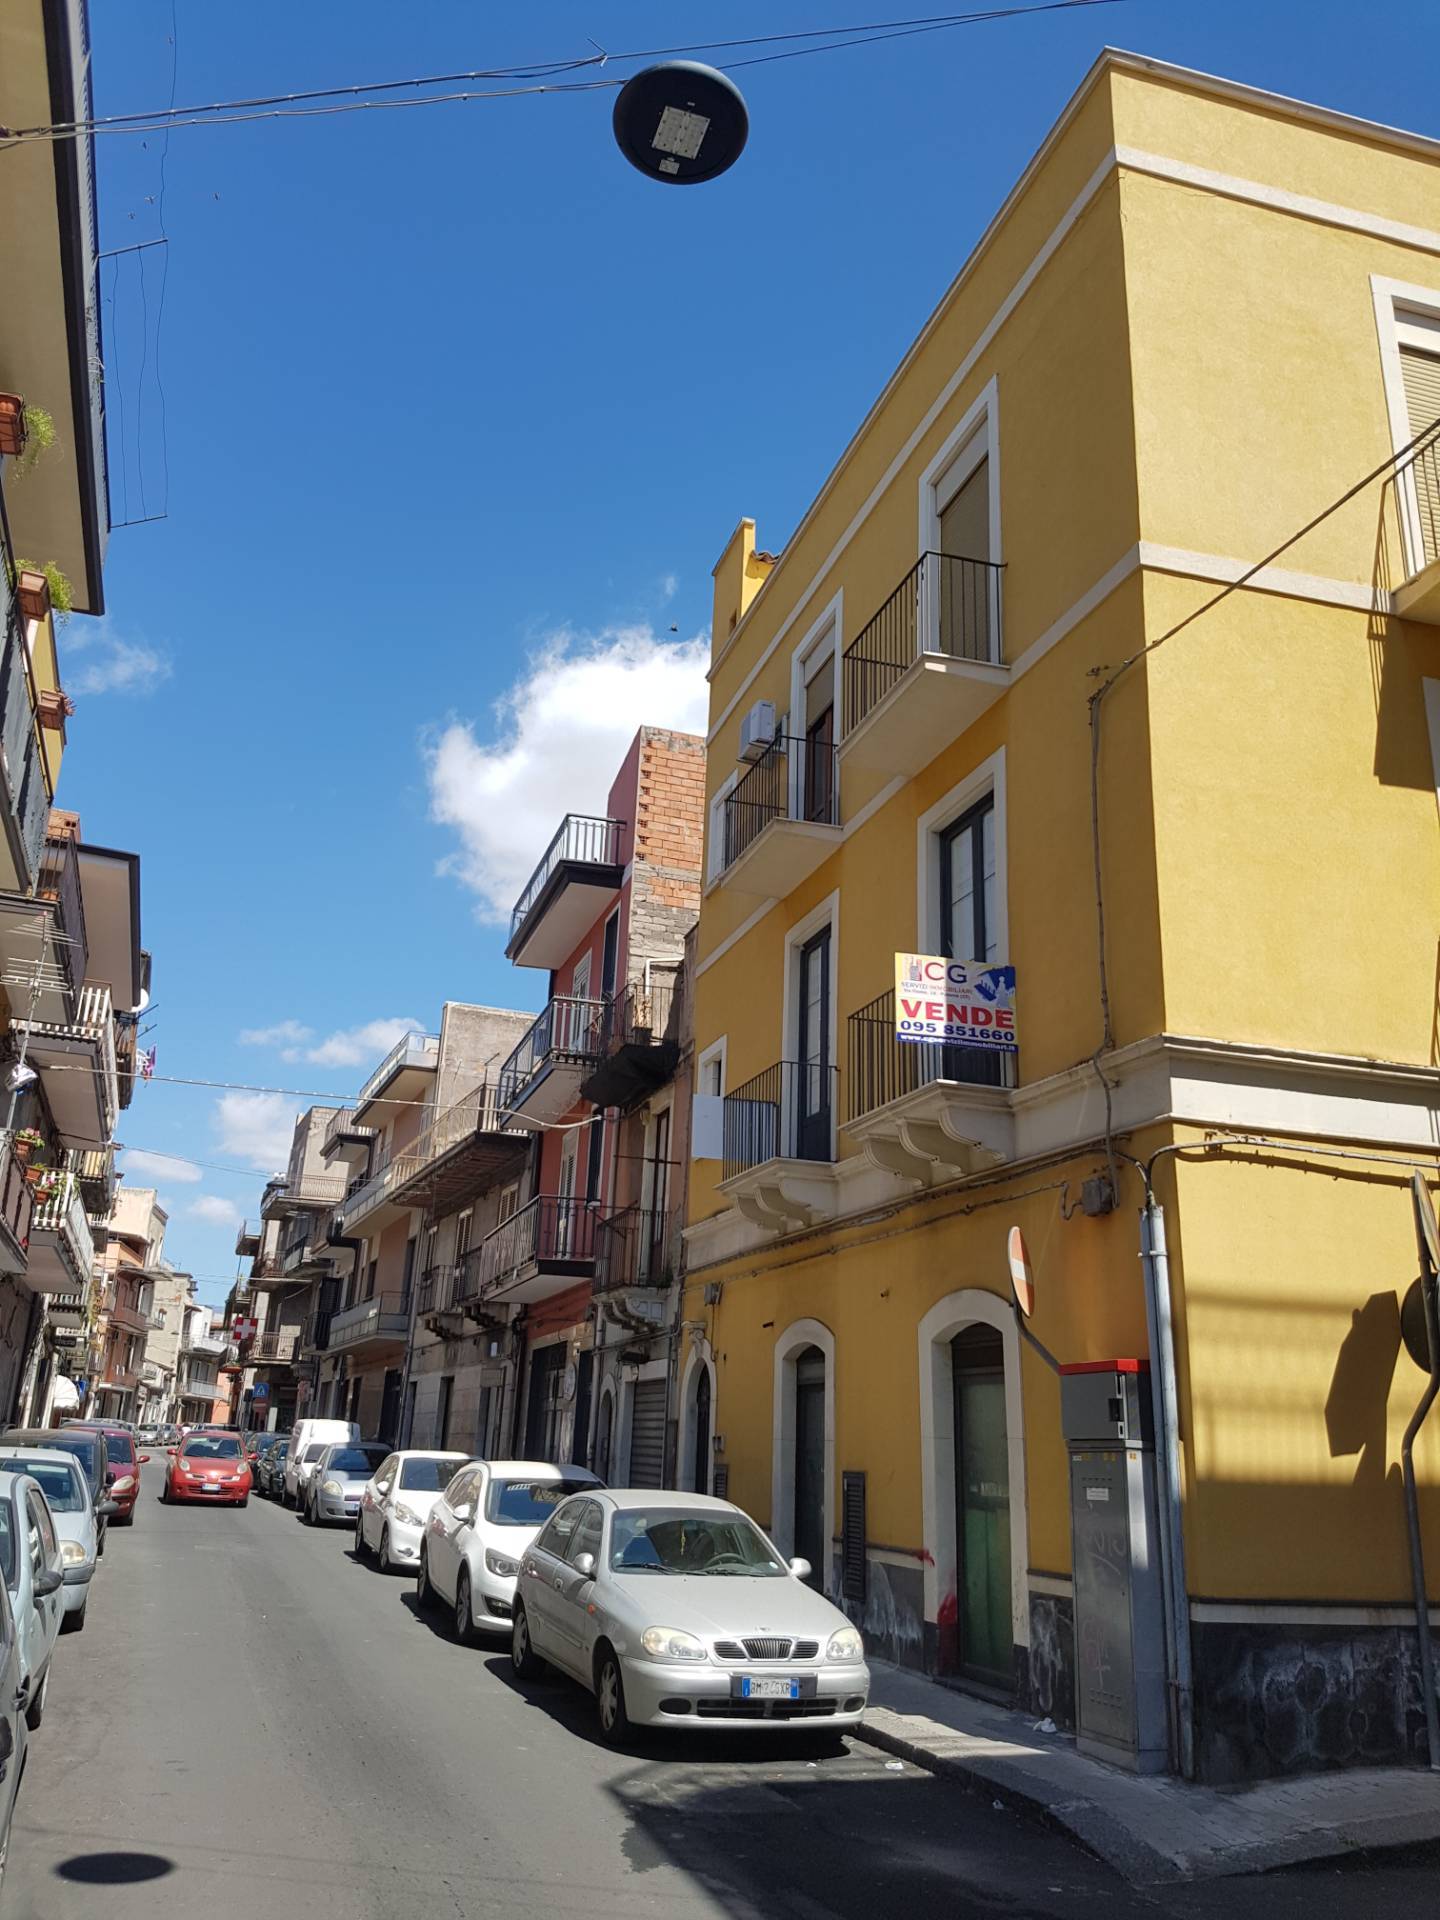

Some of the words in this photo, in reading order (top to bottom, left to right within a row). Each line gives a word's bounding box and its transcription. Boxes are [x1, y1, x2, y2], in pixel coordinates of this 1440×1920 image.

[900, 999, 1014, 1030] VENDE
[900, 1020, 936, 1033] 095
[944, 1025, 1015, 1041] 851660
